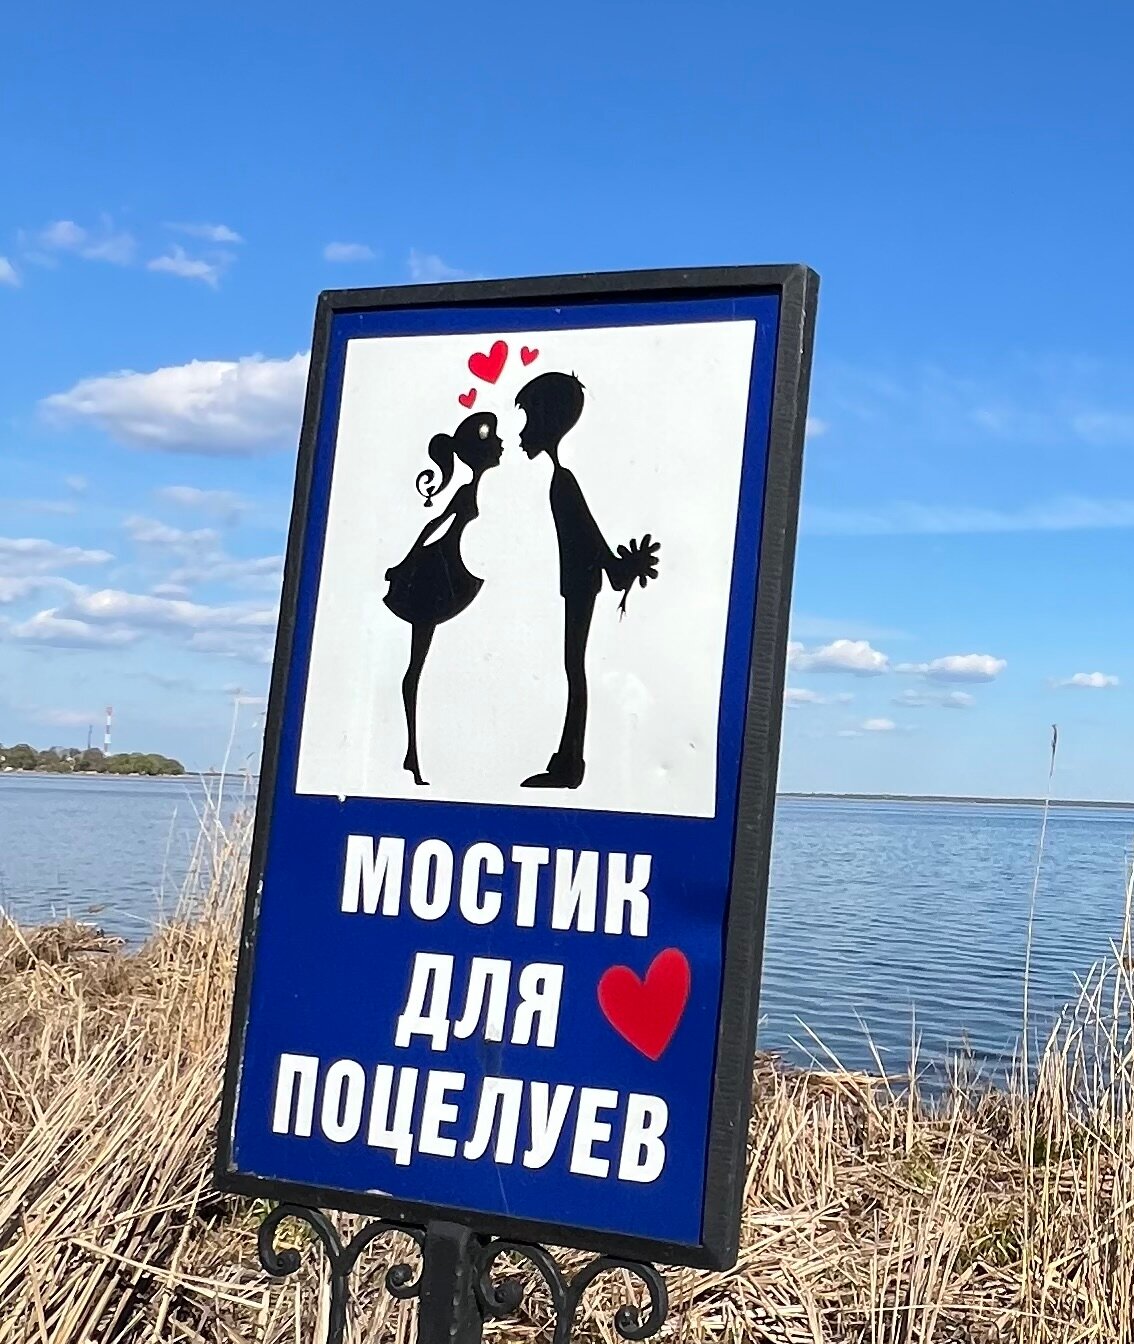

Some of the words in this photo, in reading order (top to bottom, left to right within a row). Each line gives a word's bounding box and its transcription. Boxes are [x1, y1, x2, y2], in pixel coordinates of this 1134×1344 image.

[340, 834, 652, 937] МОСТИК
[394, 952, 564, 1052] ДЛЯ
[272, 1053, 669, 1184] ПОЦЕЛУЕВ
